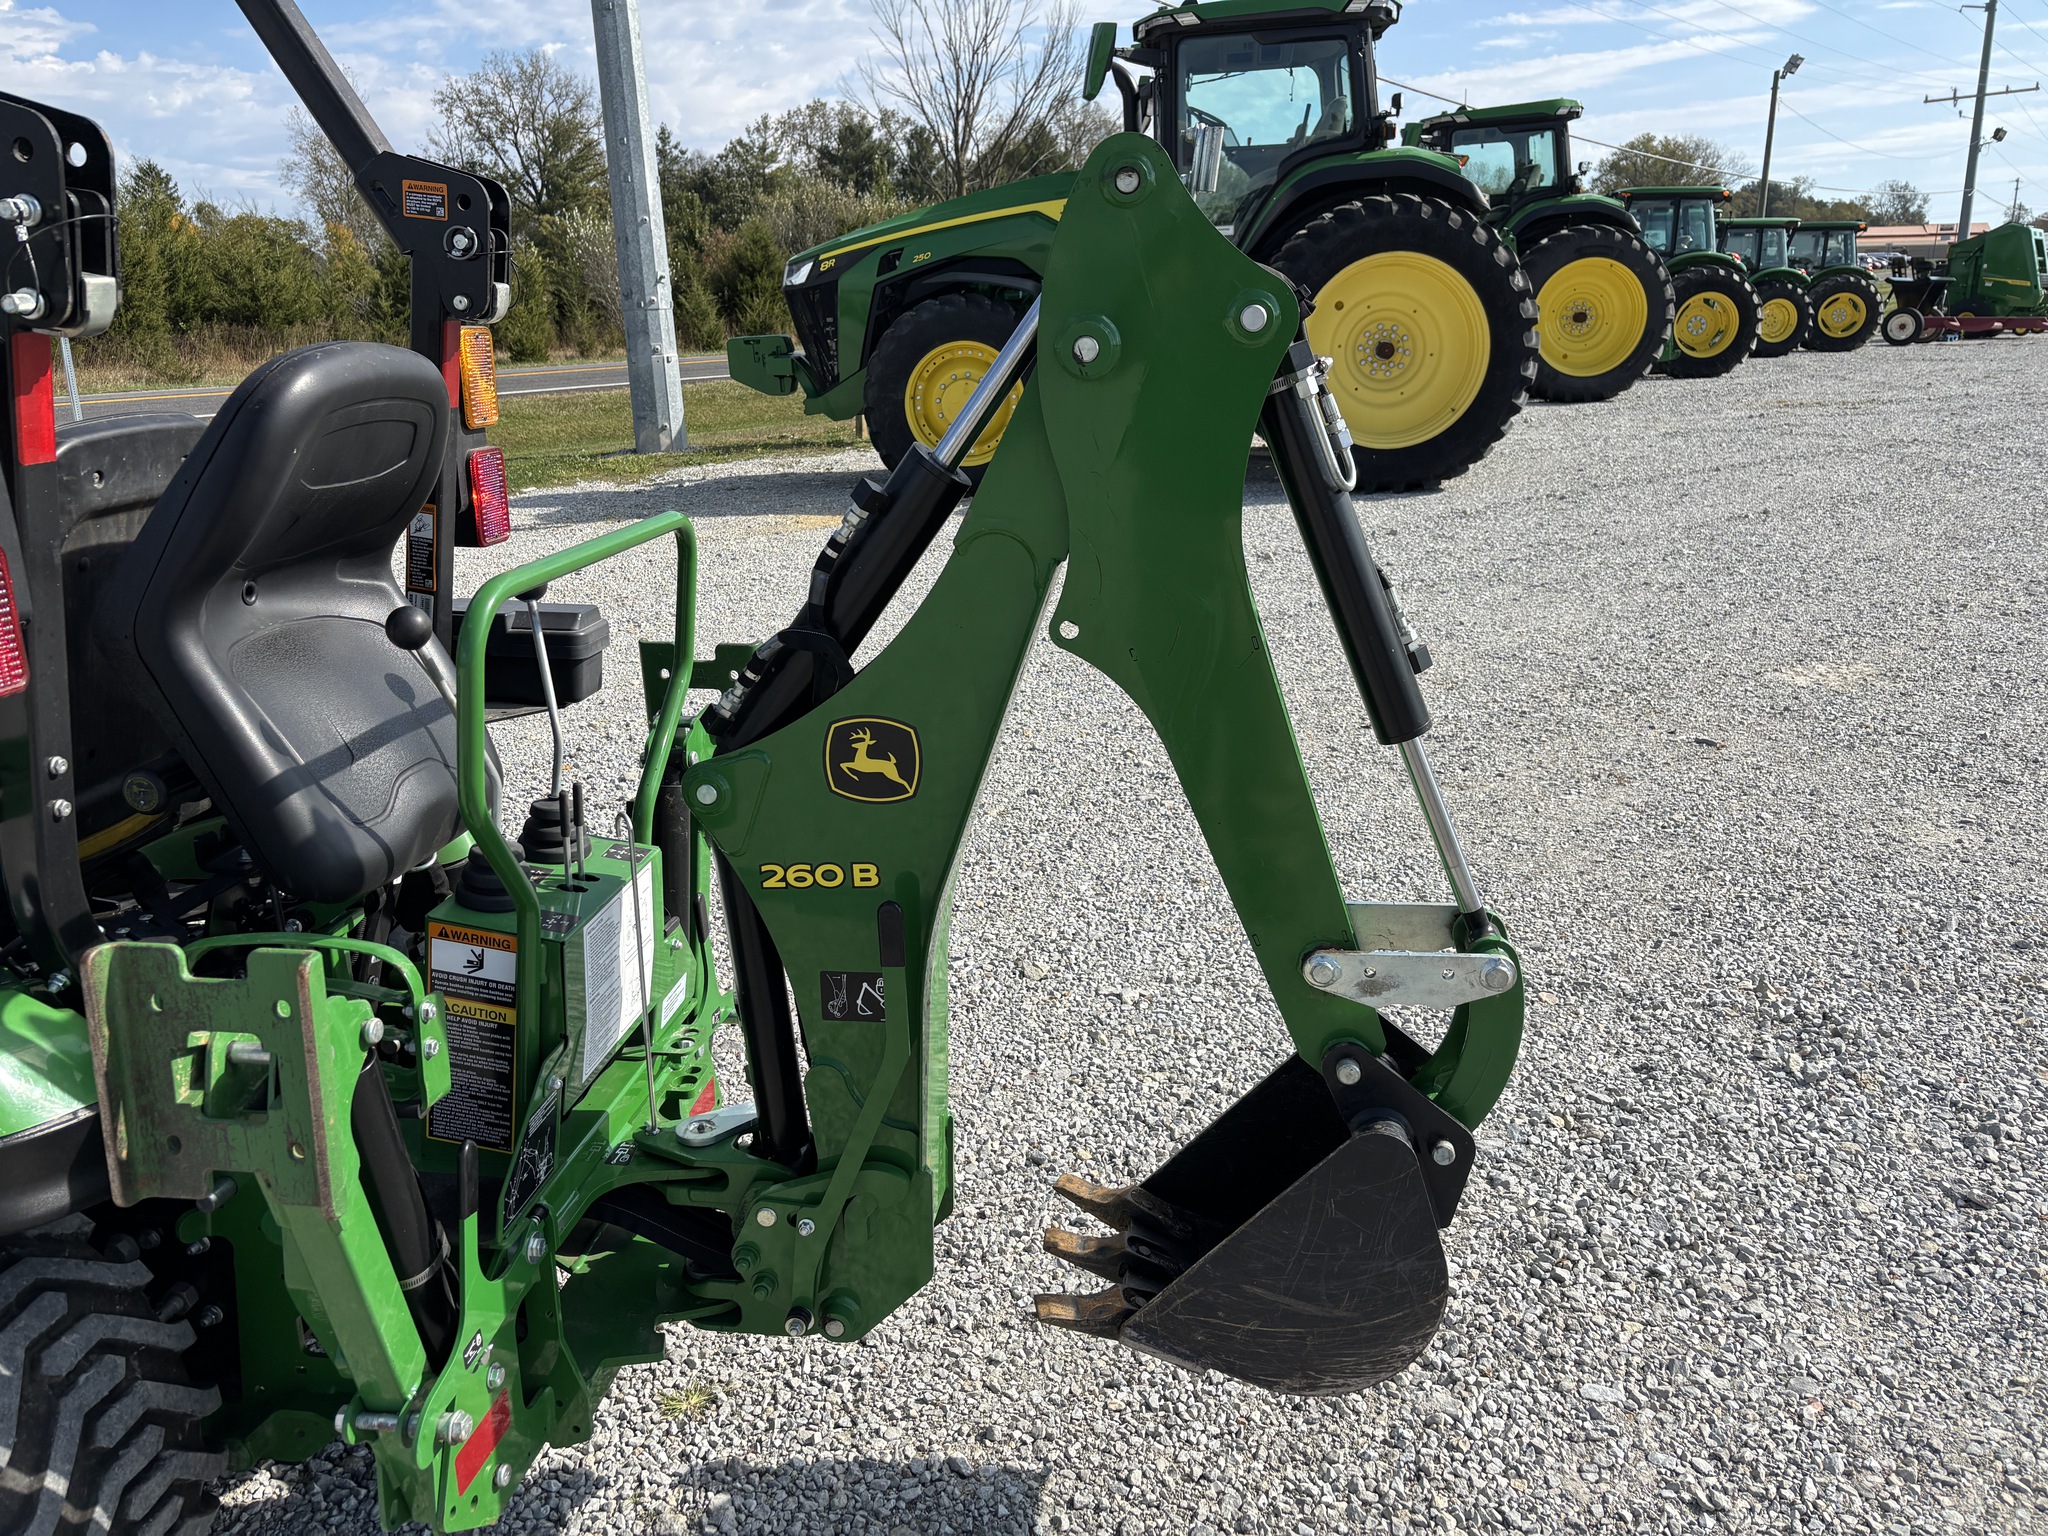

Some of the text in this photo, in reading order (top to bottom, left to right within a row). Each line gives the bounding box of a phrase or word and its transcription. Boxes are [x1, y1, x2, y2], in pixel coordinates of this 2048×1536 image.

[414, 184, 444, 193] WARNING
[820, 259, 836, 272] 8R
[912, 252, 931, 263] 250
[760, 862, 880, 889] 260 B
[450, 930, 511, 950] WARNING
[432, 972, 448, 980] AVOID
[449, 975, 467, 984] CRUSH
[468, 978, 487, 987] INJURY
[498, 983, 515, 992] DEATH
[452, 1003, 506, 1022] CAUTION
[479, 1021, 498, 1029] INJURY
